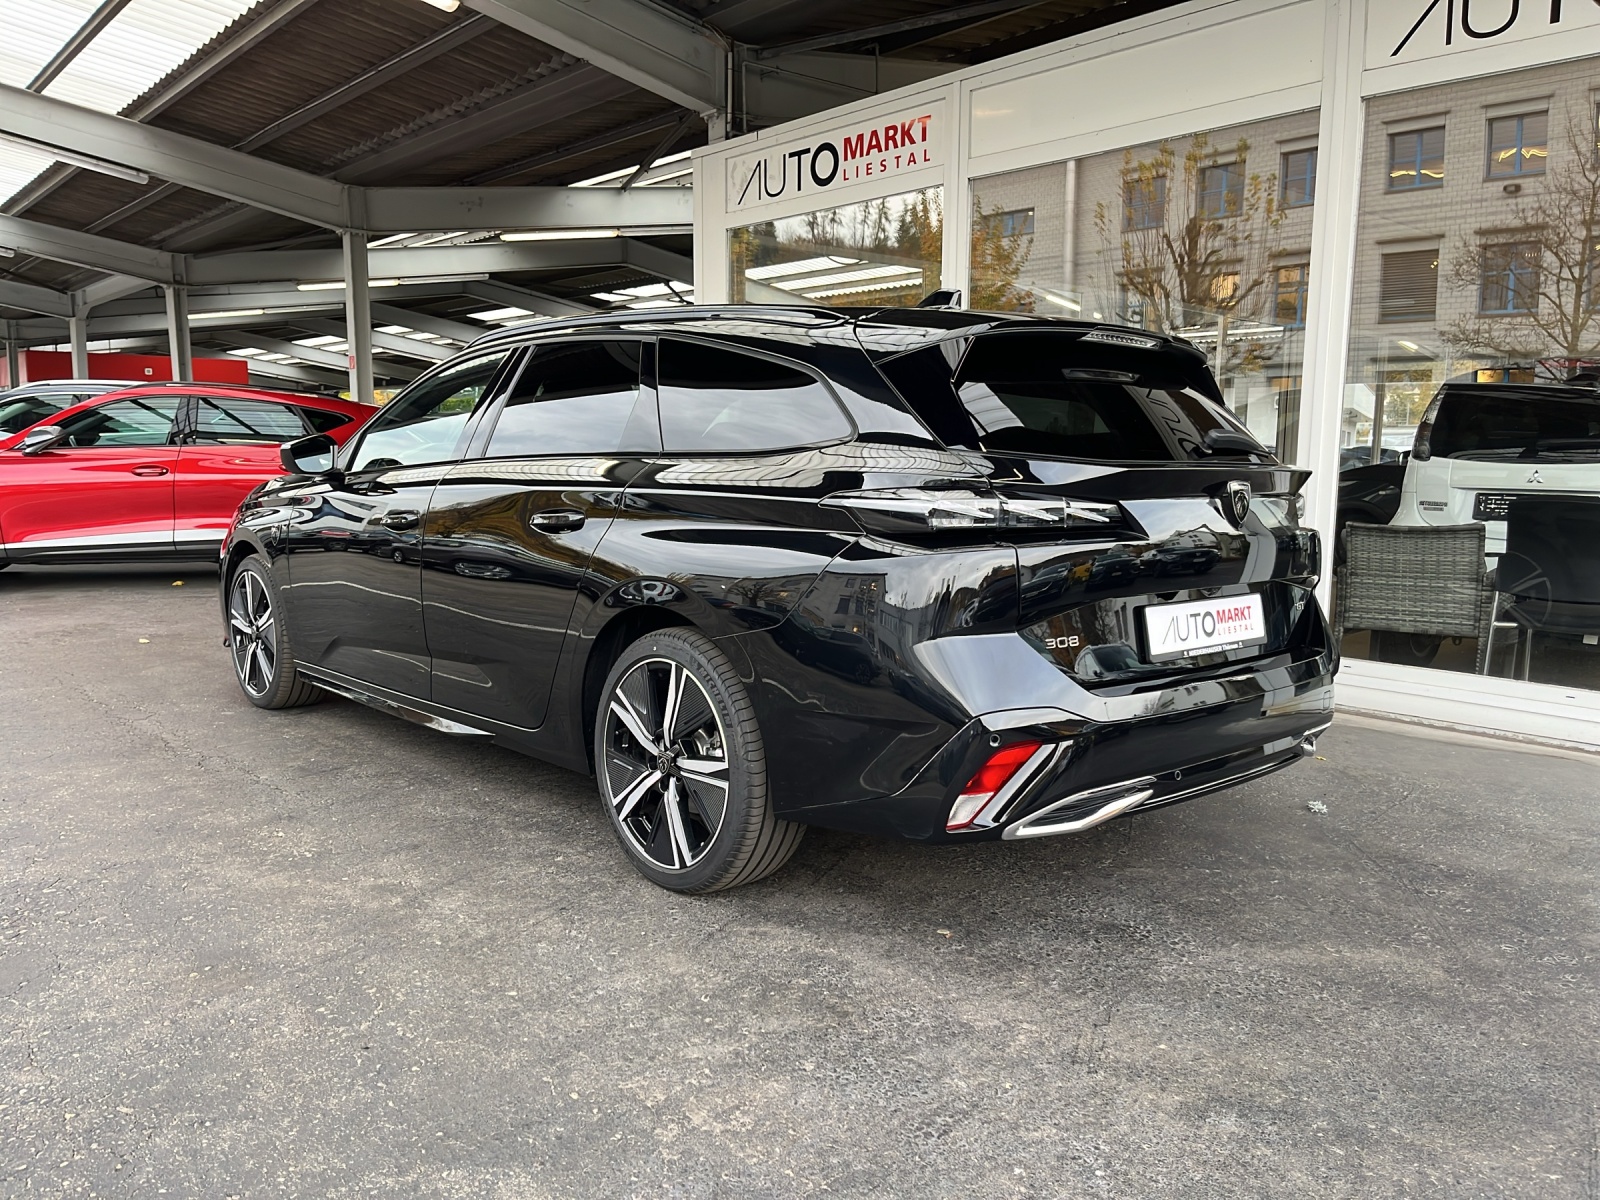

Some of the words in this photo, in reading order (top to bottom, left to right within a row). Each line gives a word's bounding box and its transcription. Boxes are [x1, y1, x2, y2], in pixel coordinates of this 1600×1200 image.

[737, 142, 840, 205] AUTO
[843, 114, 932, 162] MARKT
[843, 149, 931, 181] LIESTAL
[1162, 611, 1216, 645] AUTO
[1216, 606, 1252, 624] MARKT
[1217, 623, 1254, 636] LIESTAL
[1045, 636, 1080, 649] 308
